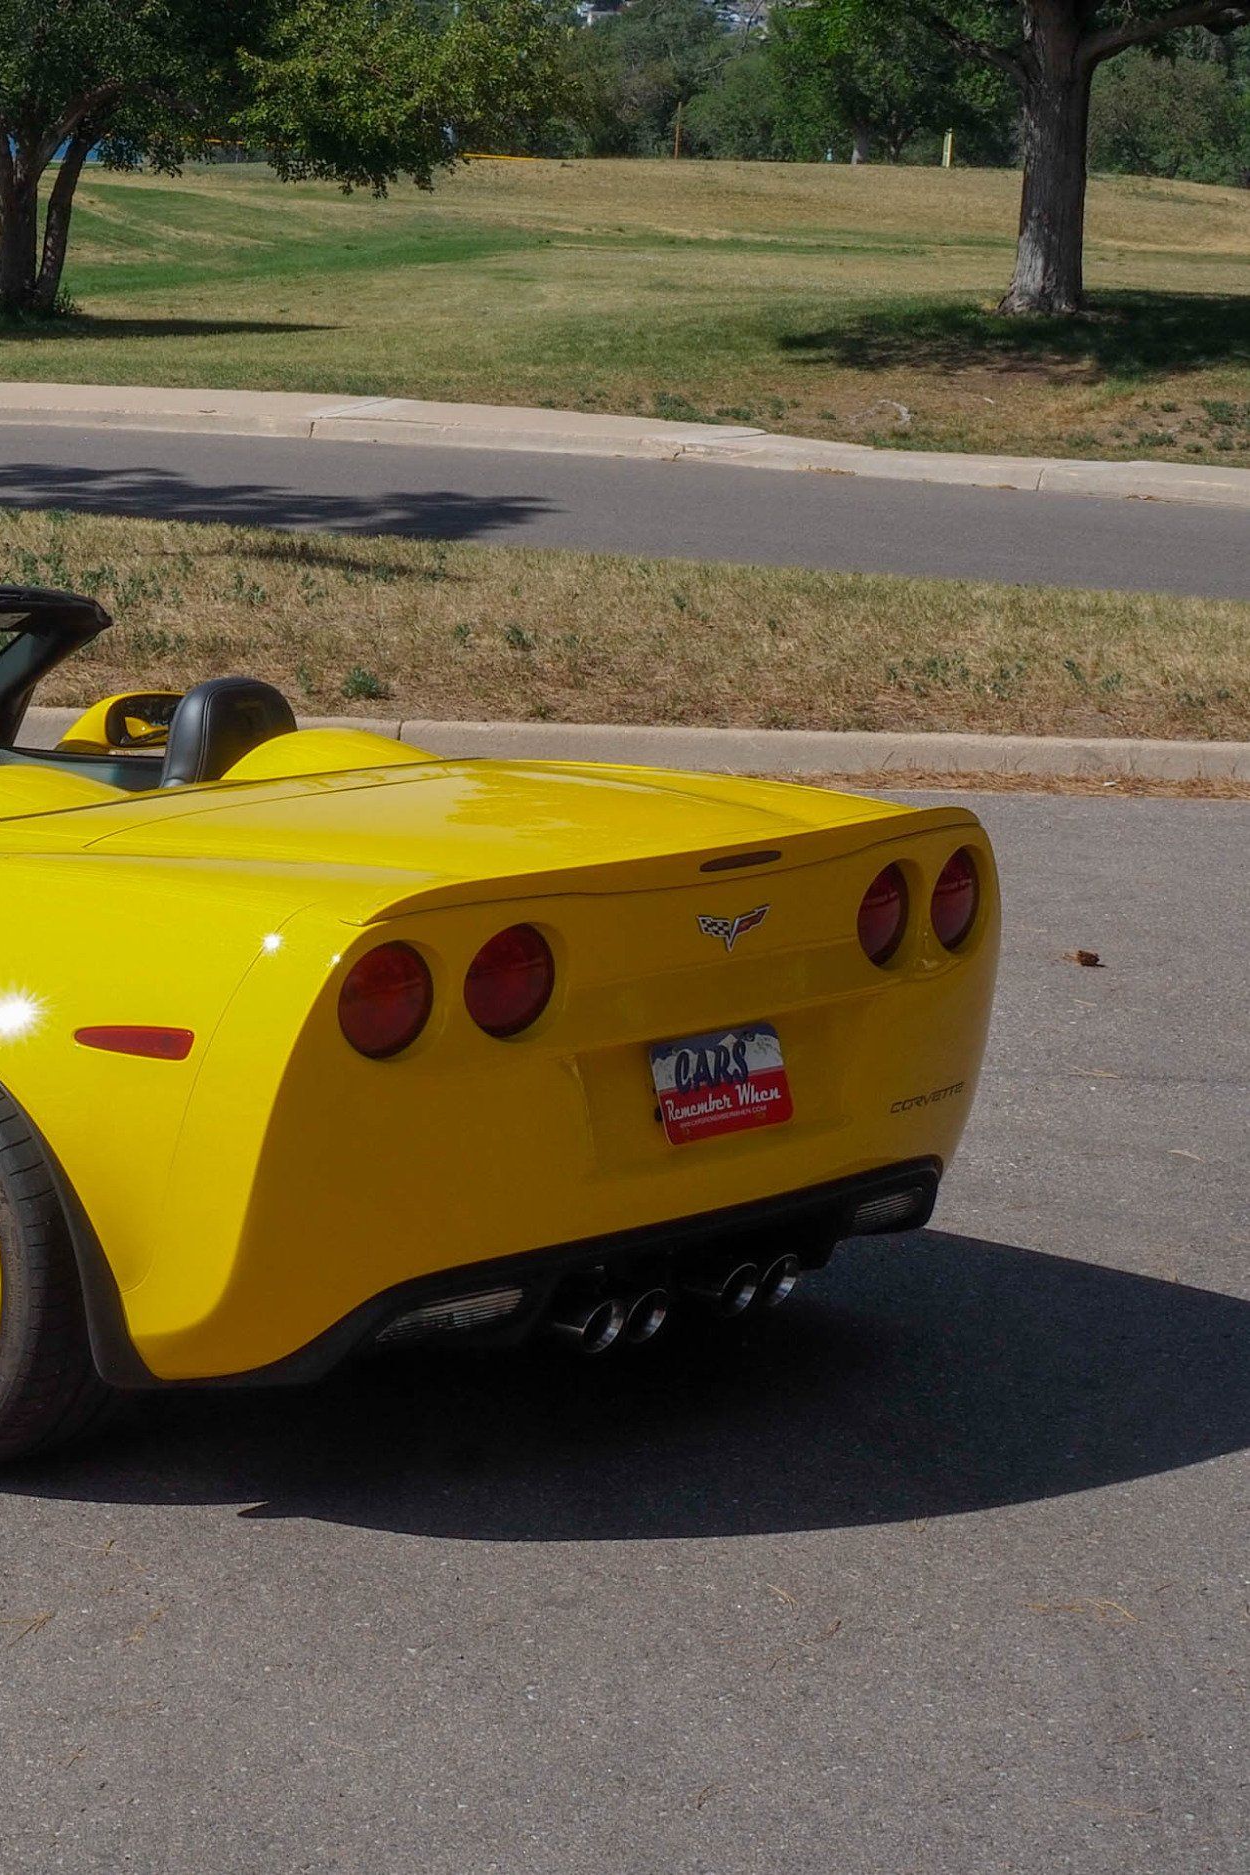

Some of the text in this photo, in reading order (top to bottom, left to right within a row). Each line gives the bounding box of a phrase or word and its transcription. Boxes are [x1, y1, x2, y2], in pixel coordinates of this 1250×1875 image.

[674, 1038, 749, 1094] CARS
[665, 1082, 782, 1122] Remember When
[890, 1080, 966, 1114] CORVETTE
